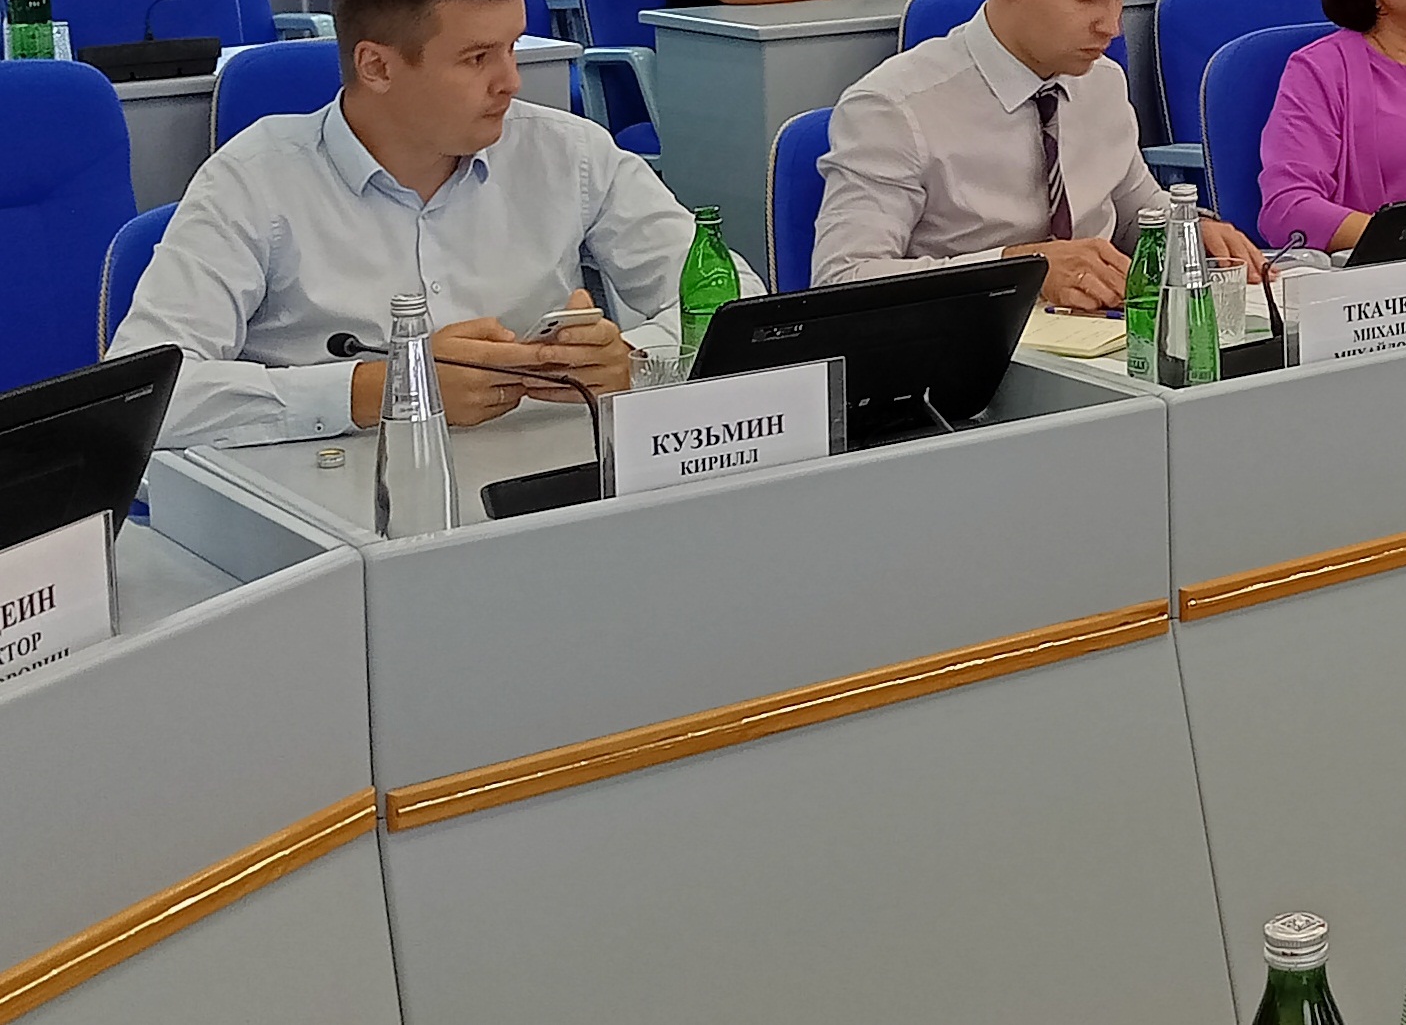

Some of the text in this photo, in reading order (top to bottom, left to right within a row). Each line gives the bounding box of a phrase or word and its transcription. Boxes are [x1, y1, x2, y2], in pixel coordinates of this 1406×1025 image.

[651, 413, 785, 457] КУЗЬМИН
[680, 448, 759, 476] КИРИЛЛ
[0, 583, 57, 632] ЕИН
